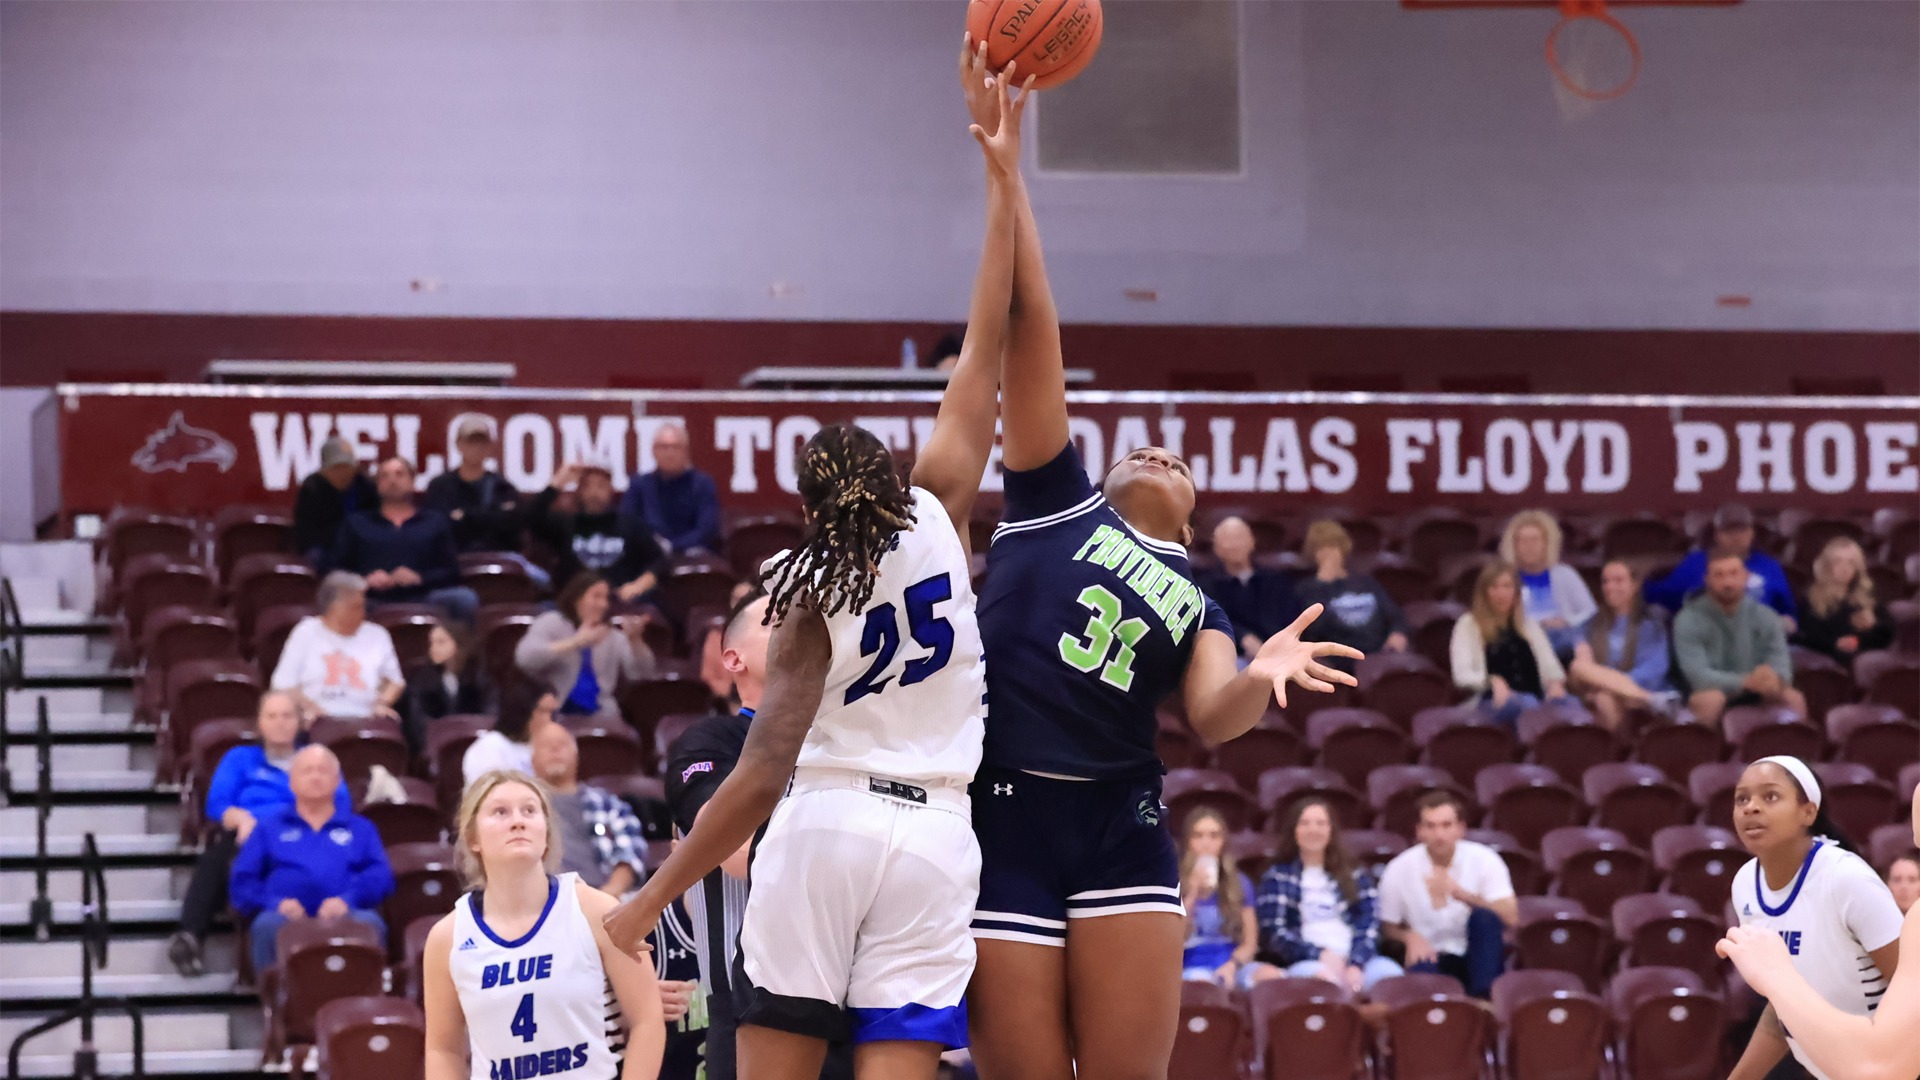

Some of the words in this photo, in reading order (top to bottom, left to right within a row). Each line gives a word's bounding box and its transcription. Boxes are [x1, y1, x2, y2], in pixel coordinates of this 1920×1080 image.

[1000, 0, 1042, 43] SPAL
[1386, 417, 1631, 494] FLOYD
[1673, 420, 1919, 494] PHOE
[1072, 524, 1201, 646] PROVIDENCE
[843, 571, 955, 706] 25
[1057, 584, 1151, 692] 31
[481, 953, 553, 989] BLUE
[510, 992, 537, 1043] 4
